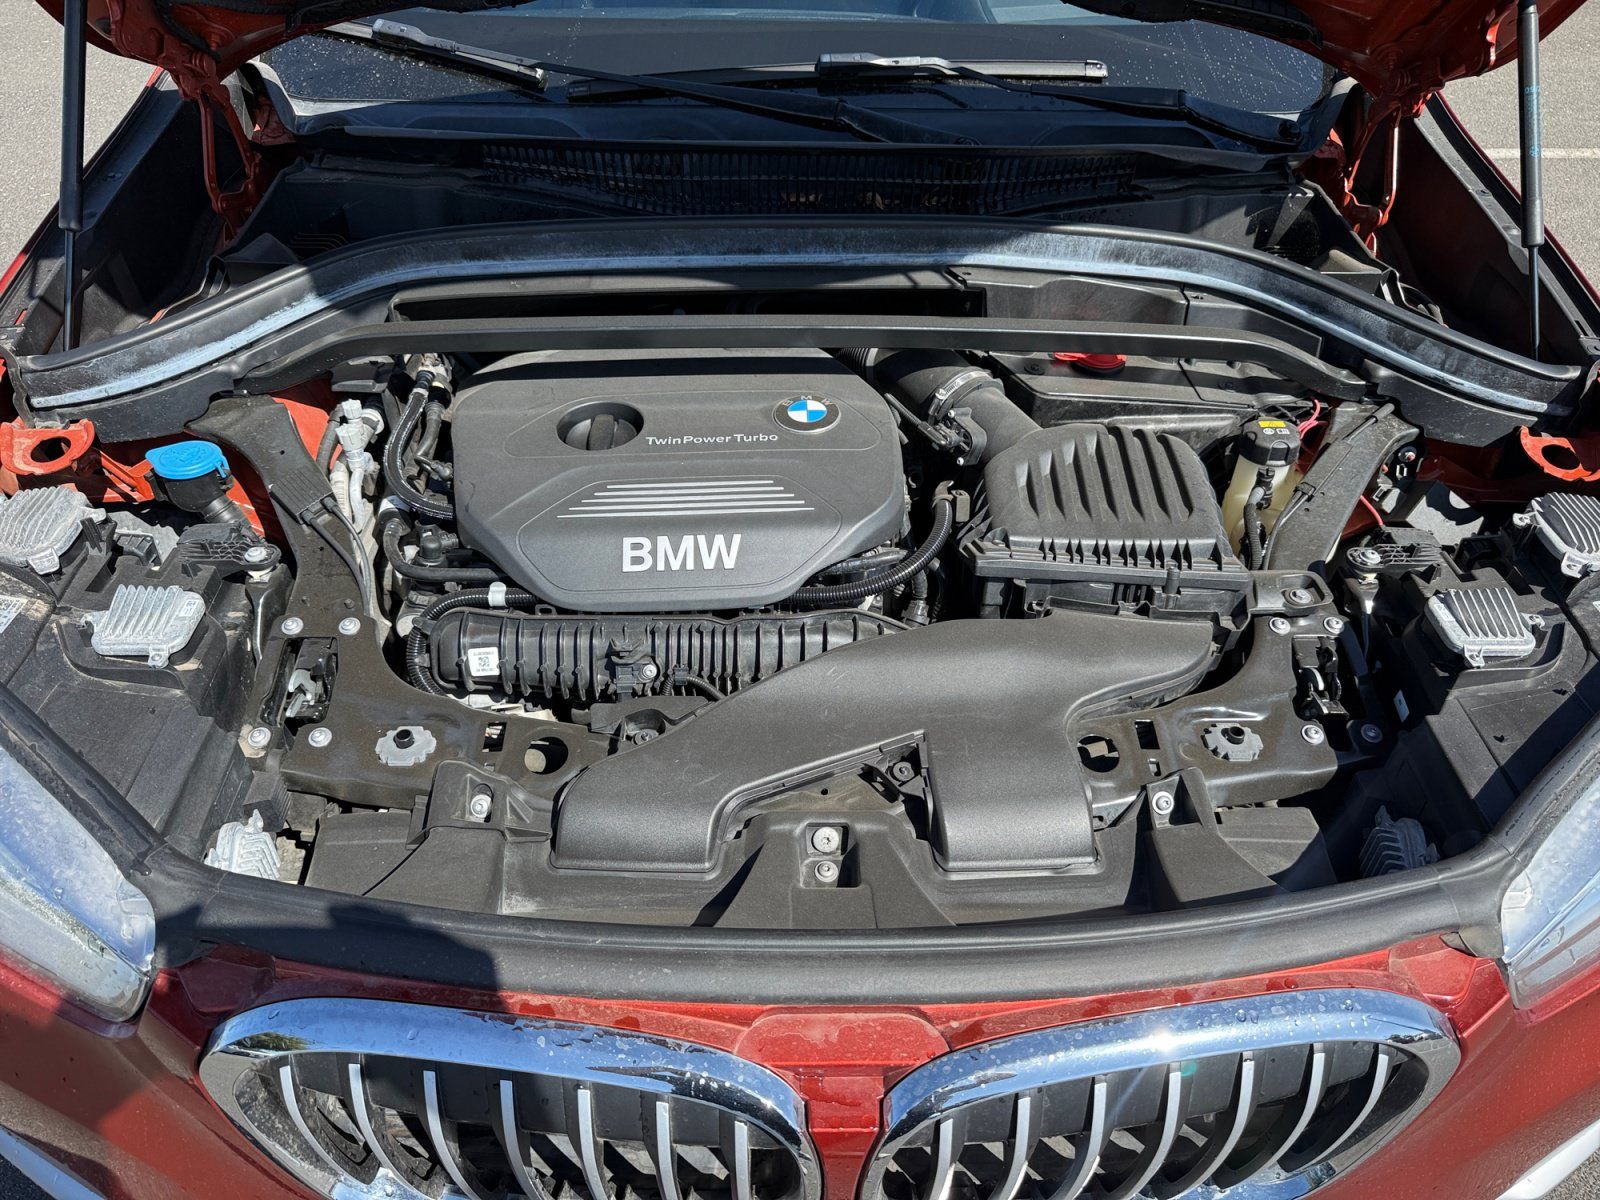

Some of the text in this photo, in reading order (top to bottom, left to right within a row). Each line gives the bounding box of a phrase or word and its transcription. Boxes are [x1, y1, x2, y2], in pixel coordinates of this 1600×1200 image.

[782, 395, 833, 406] BMW
[733, 433, 779, 443] Turbo
[622, 533, 742, 572] BMW
